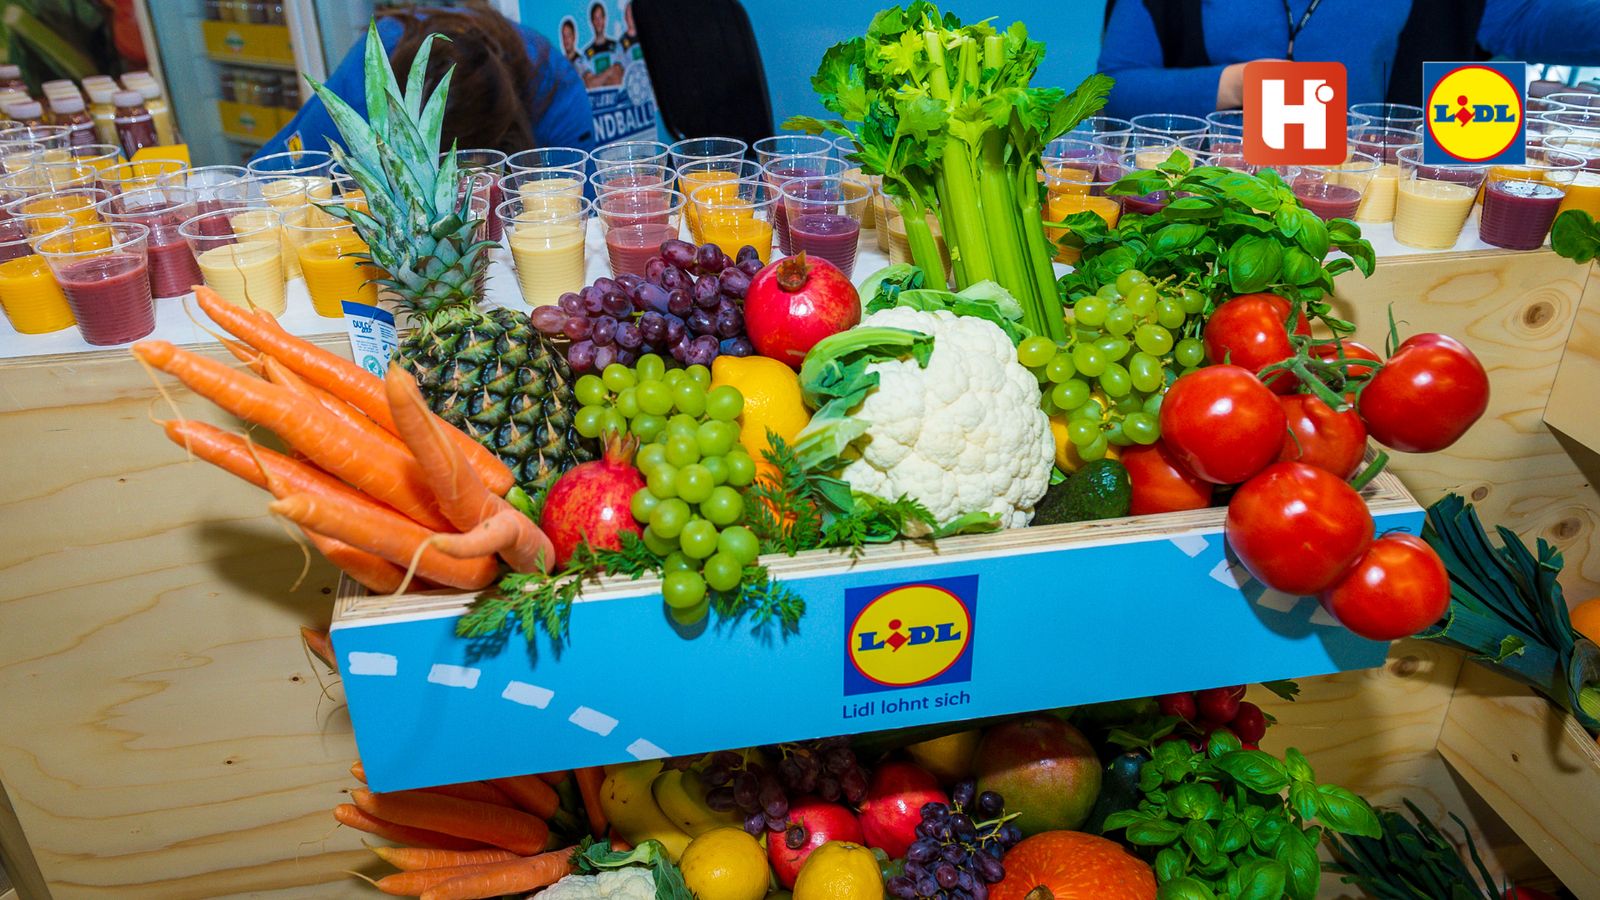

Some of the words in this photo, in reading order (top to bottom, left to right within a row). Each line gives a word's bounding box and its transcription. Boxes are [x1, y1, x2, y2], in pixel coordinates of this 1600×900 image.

[593, 103, 652, 143] NDBALL
[842, 701, 875, 719] Lidl
[881, 697, 929, 714] lohnt
[934, 690, 971, 708] sich
